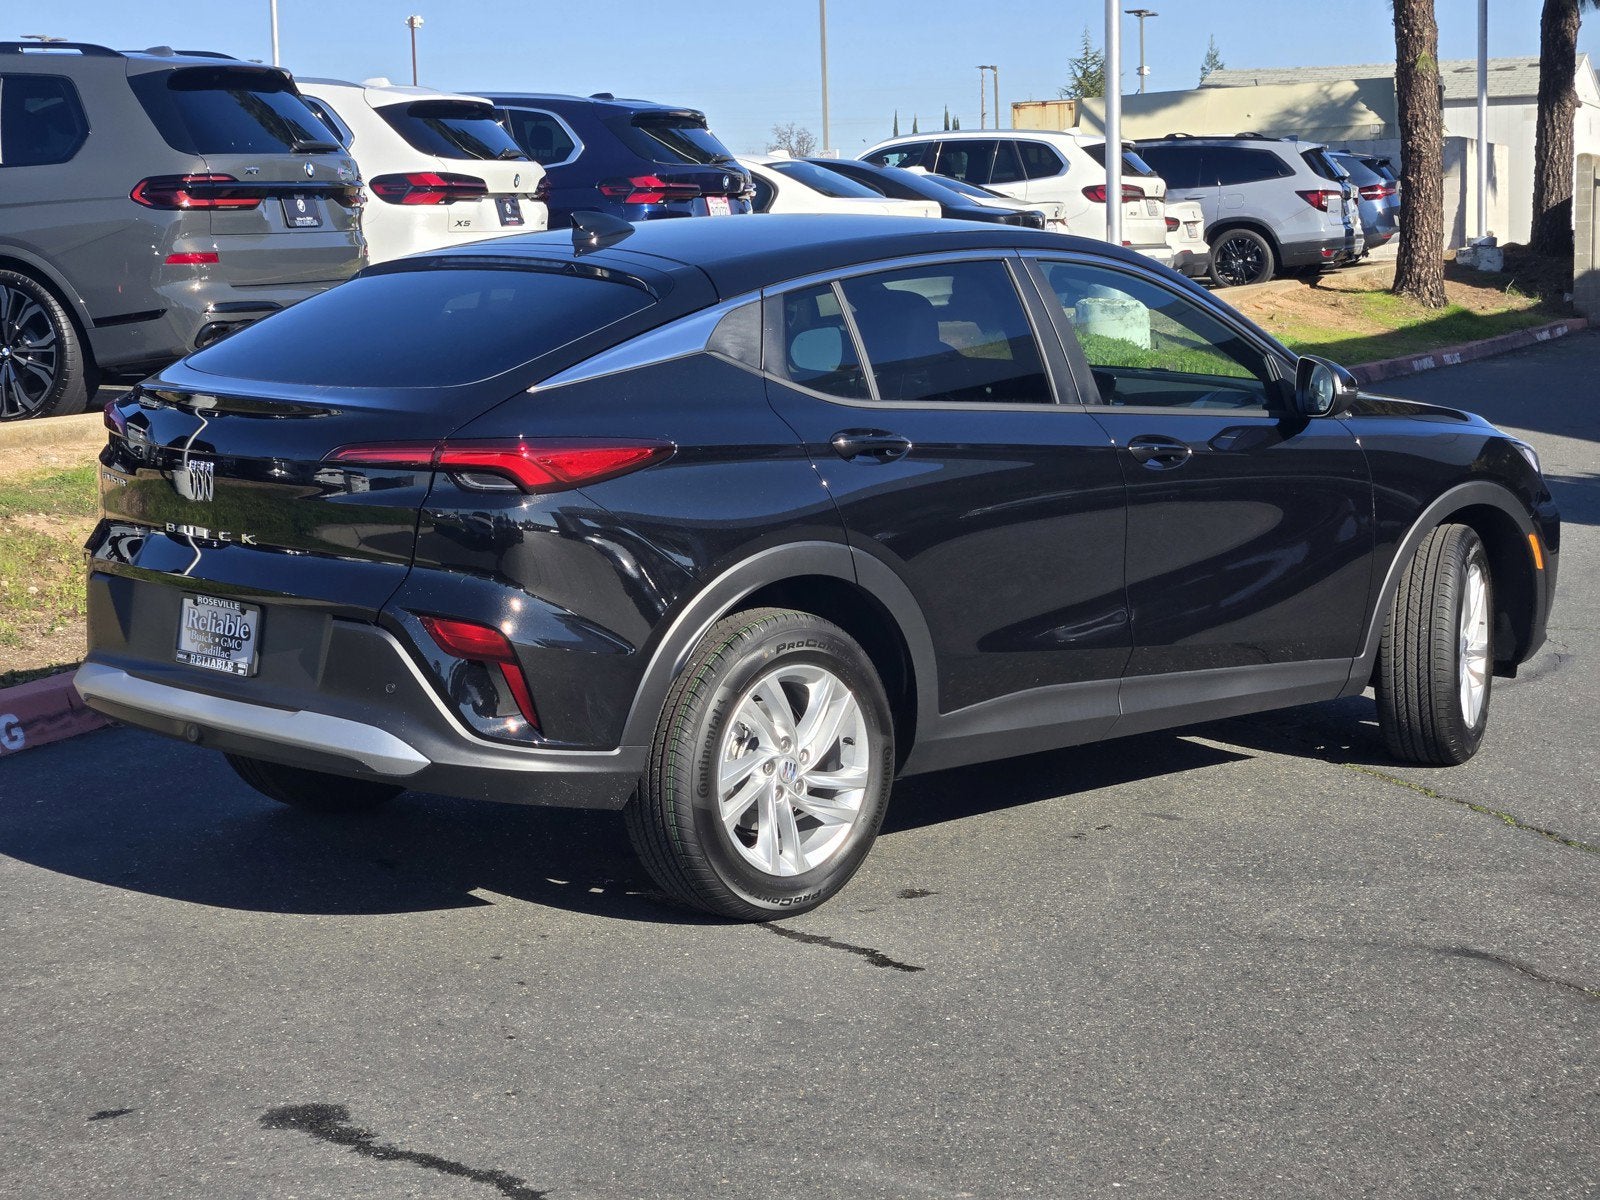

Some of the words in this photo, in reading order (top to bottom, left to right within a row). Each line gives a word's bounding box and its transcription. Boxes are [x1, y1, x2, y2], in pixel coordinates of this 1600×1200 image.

[165, 522, 257, 545] BUICK
[197, 596, 240, 610] ROSEVILLE
[187, 607, 250, 639] Reliable
[190, 629, 213, 643] Buick
[220, 637, 242, 650] GMC
[197, 643, 231, 659] Cadillac
[189, 654, 234, 672] RELIABLE
[697, 709, 722, 798] Continental
